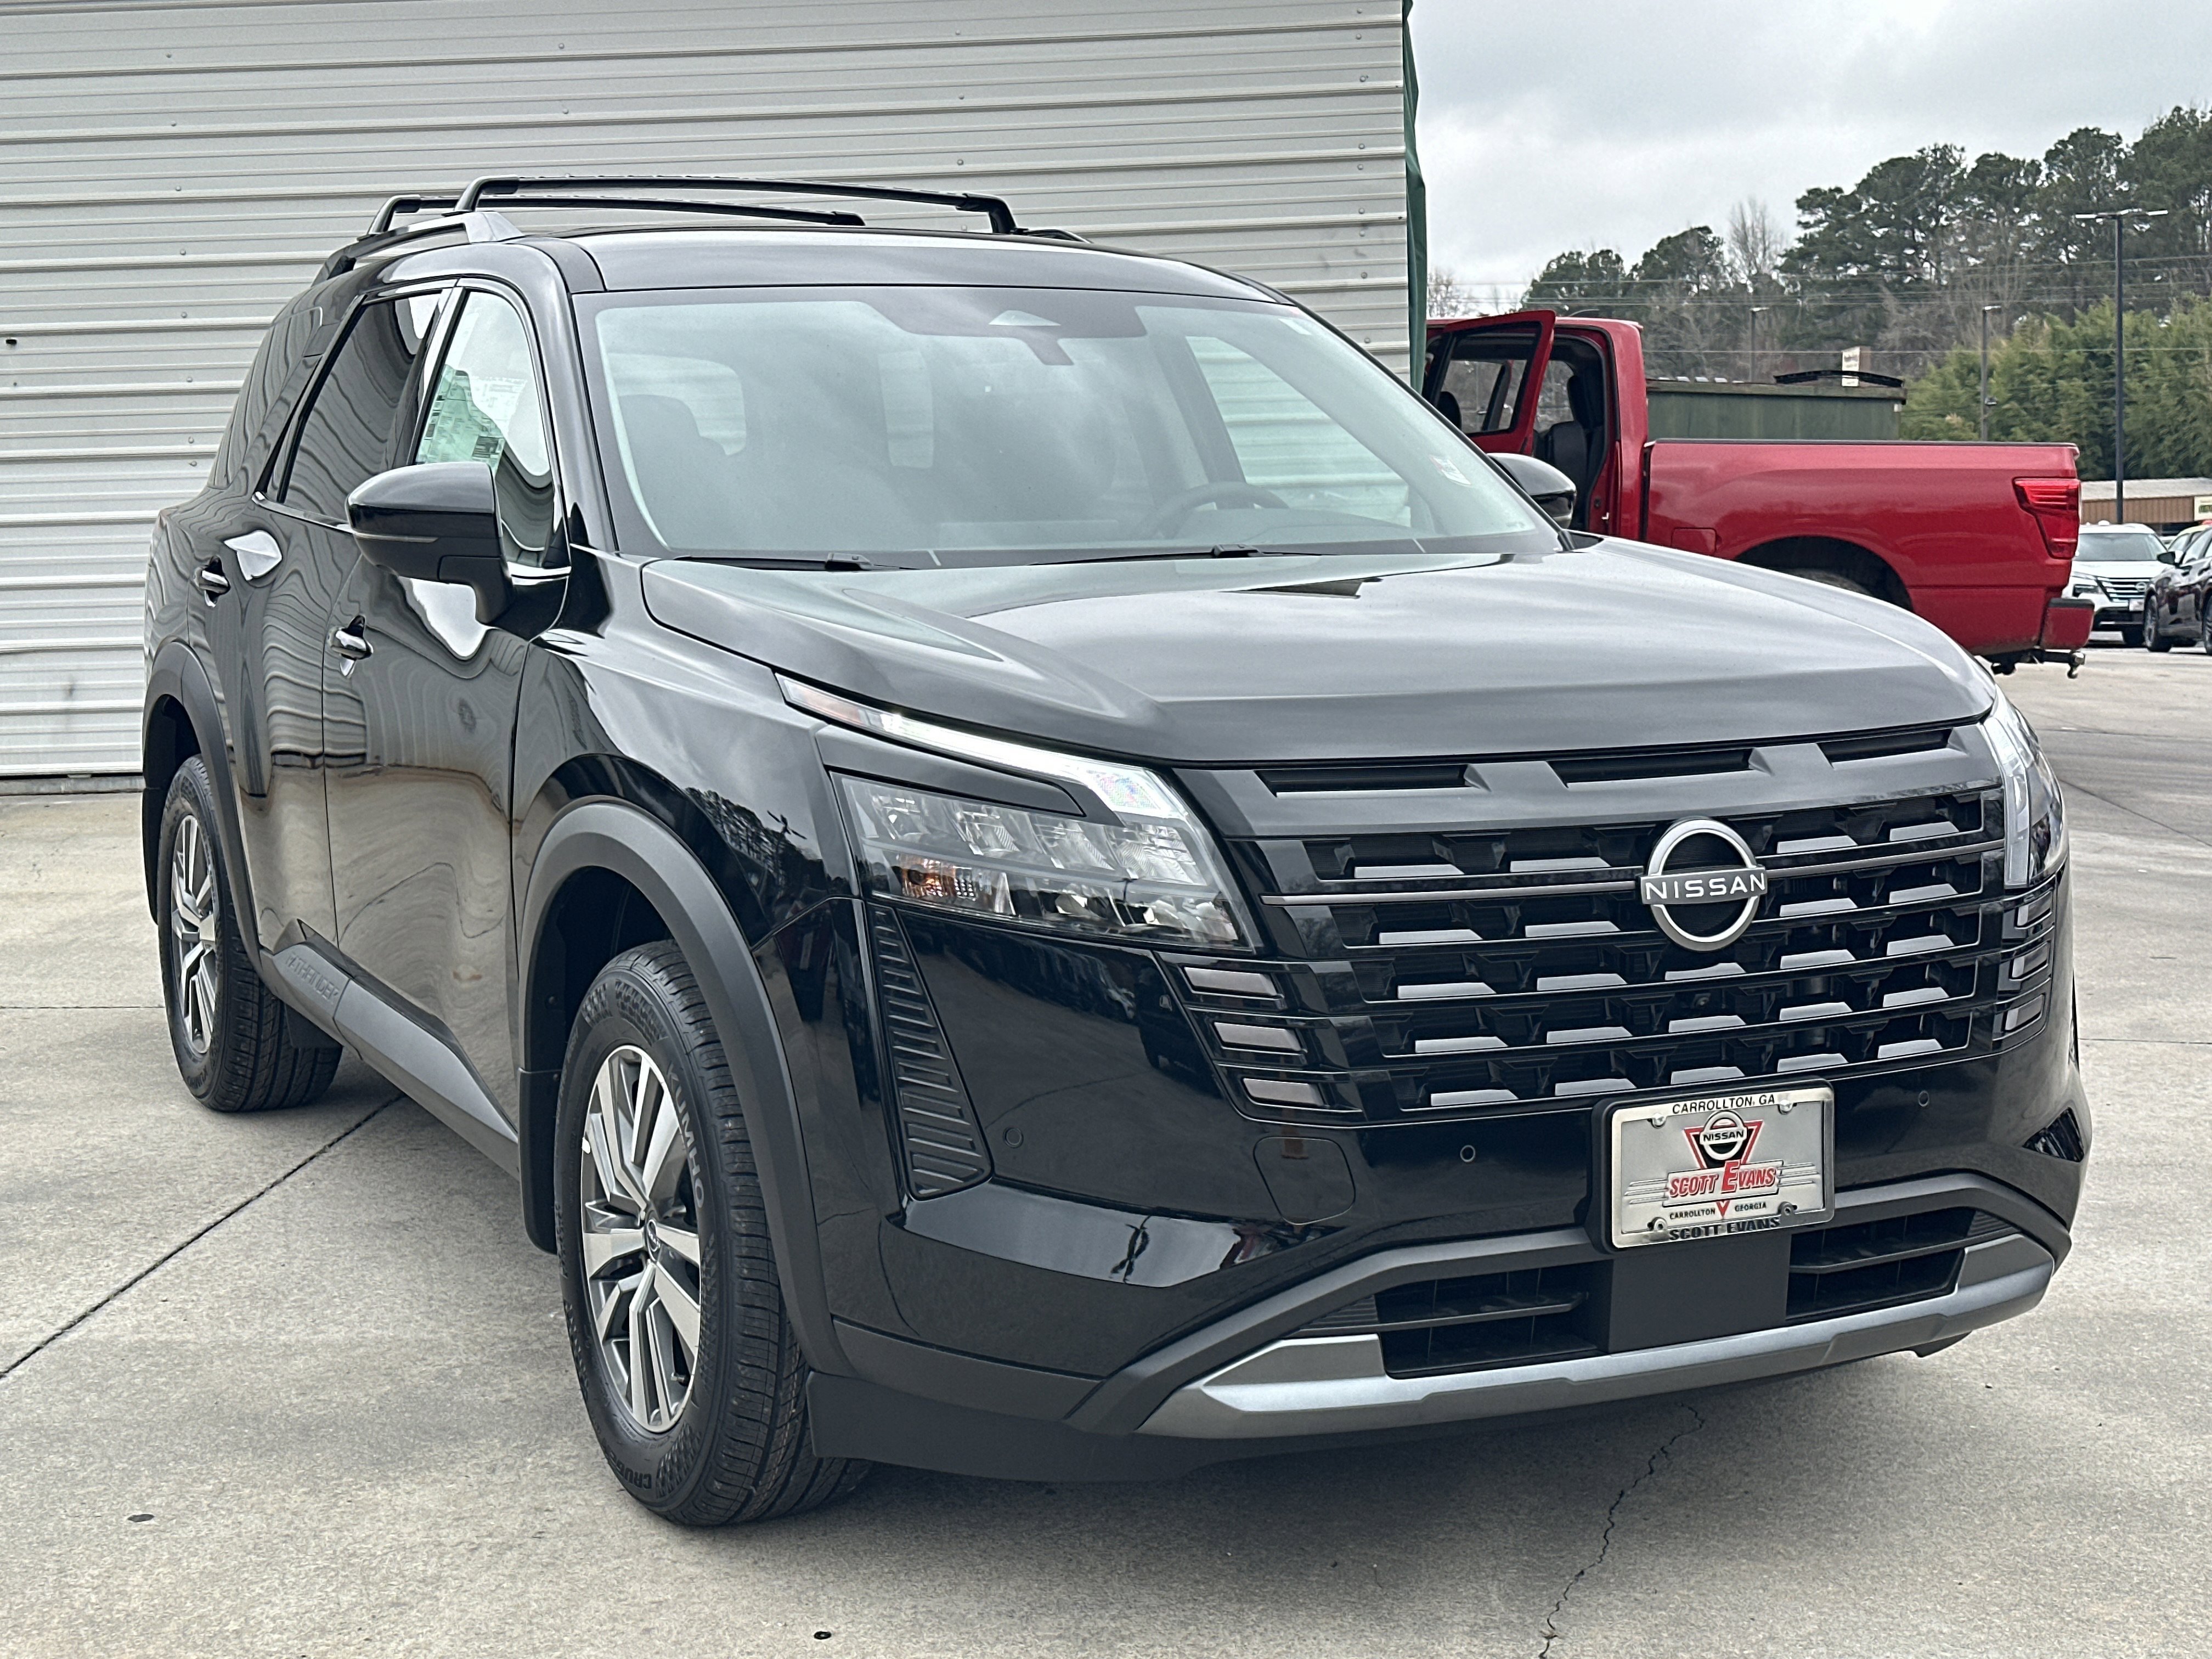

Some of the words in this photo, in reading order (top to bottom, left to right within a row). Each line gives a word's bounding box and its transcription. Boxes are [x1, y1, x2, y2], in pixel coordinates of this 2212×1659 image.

[1645, 872, 1765, 900] NISSAN
[285, 953, 339, 1006] PATHFINDER
[1759, 1094, 1775, 1105] GA
[667, 1062, 704, 1208] KUMHO
[1703, 1130, 1744, 1141] NISSAN
[1669, 1173, 1719, 1198] SCOTT
[1669, 1207, 1716, 1220] CARROLLTON
[1734, 1202, 1767, 1212] GEORGIA
[1669, 1224, 1722, 1241] SCOTT
[1726, 1217, 1781, 1233] EVANS
